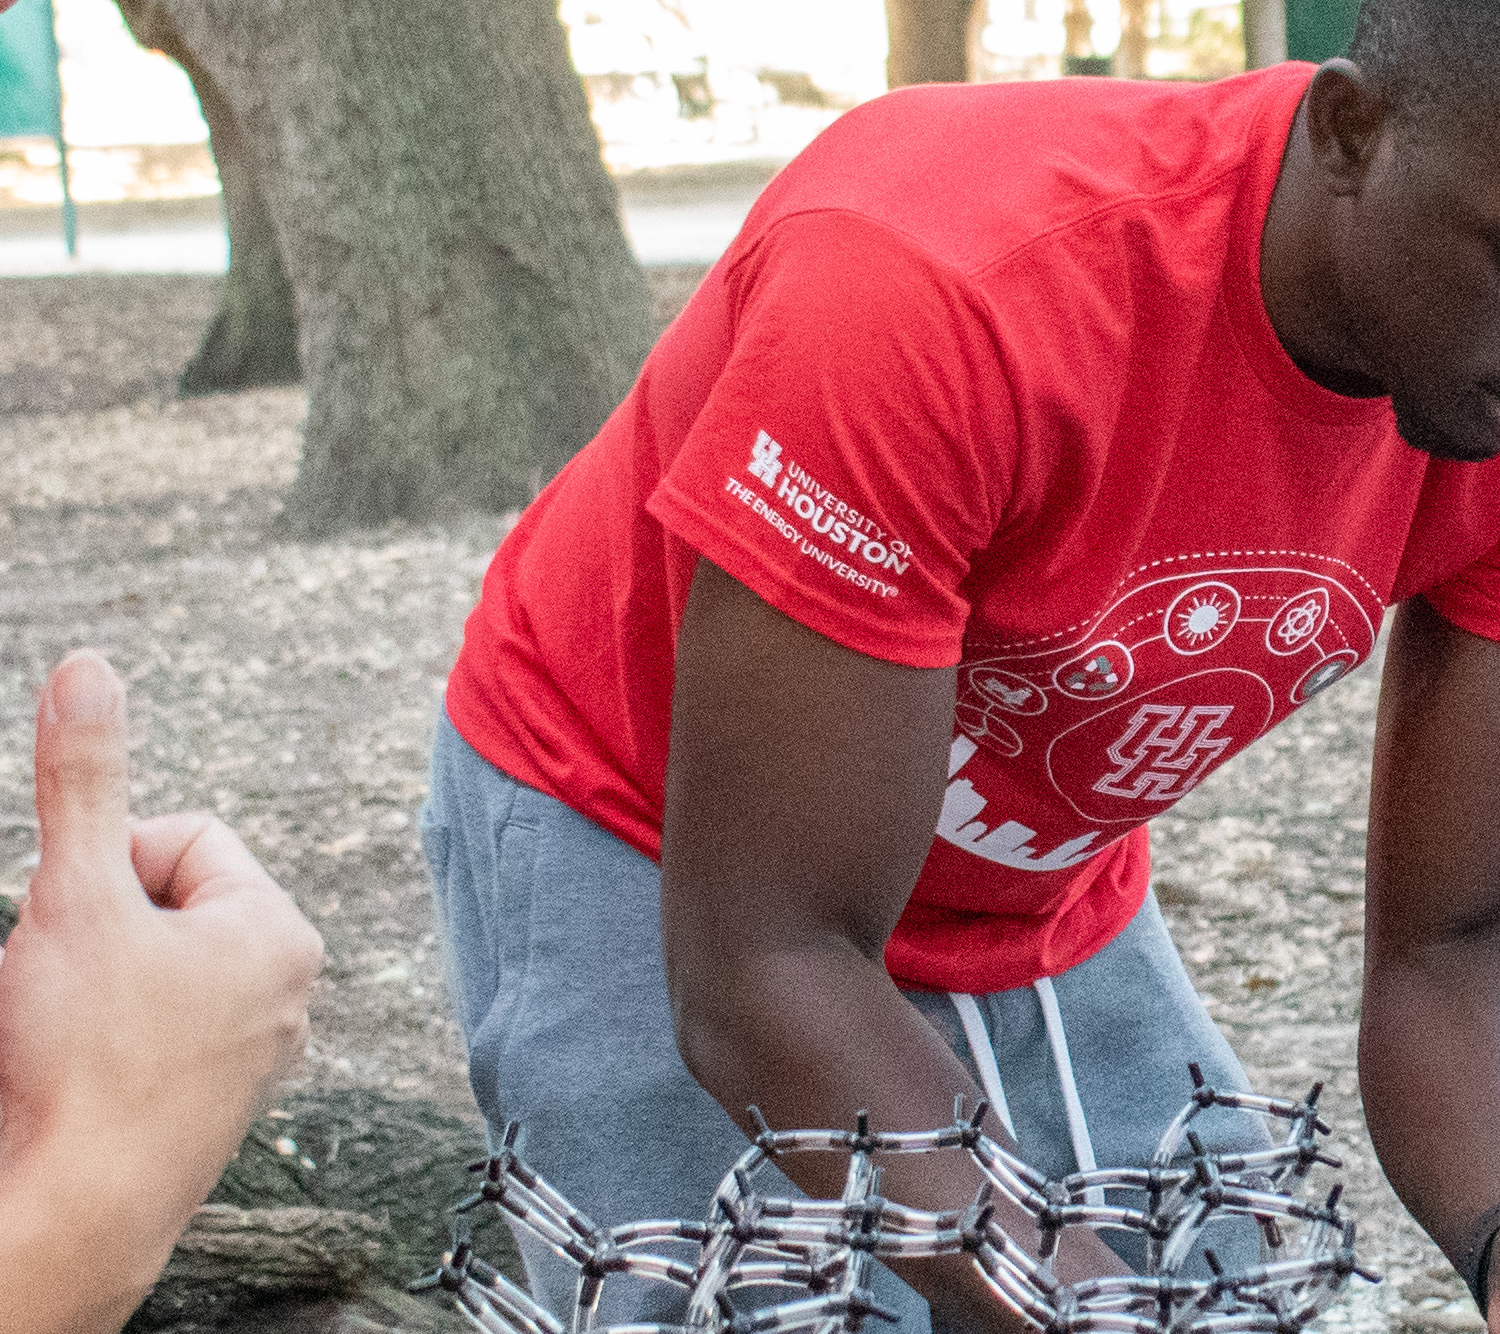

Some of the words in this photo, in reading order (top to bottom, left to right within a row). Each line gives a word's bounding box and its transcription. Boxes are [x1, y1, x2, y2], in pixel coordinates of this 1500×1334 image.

[725, 477, 756, 506] THE
[753, 498, 802, 544] ENERGY
[777, 477, 910, 575] HOUSTON
[788, 461, 887, 540] UNIVERSITY
